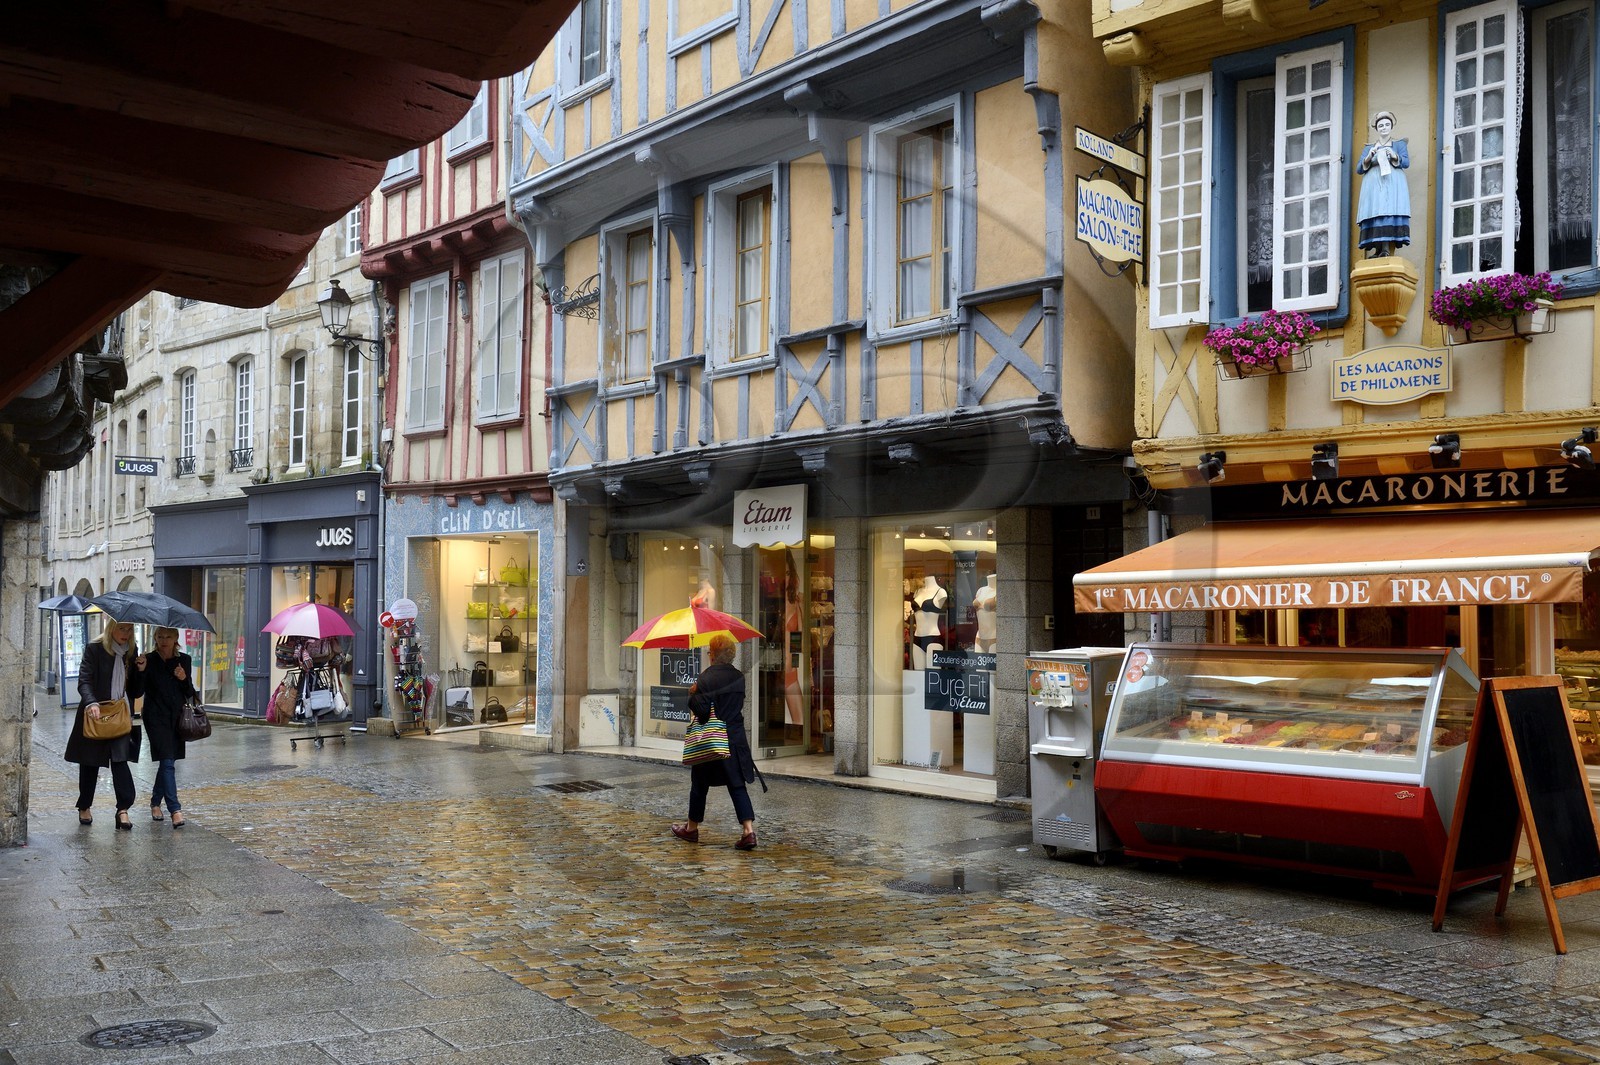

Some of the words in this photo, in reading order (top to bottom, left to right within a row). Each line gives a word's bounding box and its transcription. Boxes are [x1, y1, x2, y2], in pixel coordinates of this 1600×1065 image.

[1079, 132, 1114, 159] ROLLAND
[1079, 186, 1141, 229] MACARONIER
[1079, 211, 1117, 246] SALON
[1121, 228, 1141, 256] THE
[1339, 364, 1362, 377] LES
[1366, 356, 1443, 374] MACARONS
[1341, 380, 1357, 392] DE
[1361, 374, 1441, 391] PHILOMENE
[1281, 467, 1569, 507] MACARONERIE
[743, 499, 793, 525] Etam
[743, 524, 791, 533] LINGERIE
[1093, 586, 1117, 610] 1er
[1123, 582, 1314, 609] MACARONIER
[1327, 580, 1371, 605] DE
[1390, 575, 1532, 603] FRANCE
[662, 654, 687, 675] Pure
[933, 653, 939, 664] 2
[938, 655, 977, 668] soutiens-gorge
[1026, 660, 1057, 671] VANILLE
[928, 671, 966, 697] Pure
[968, 673, 987, 698] Fit
[959, 695, 987, 710] Etam
[651, 706, 664, 719] Pure
[663, 709, 691, 721] sensation
